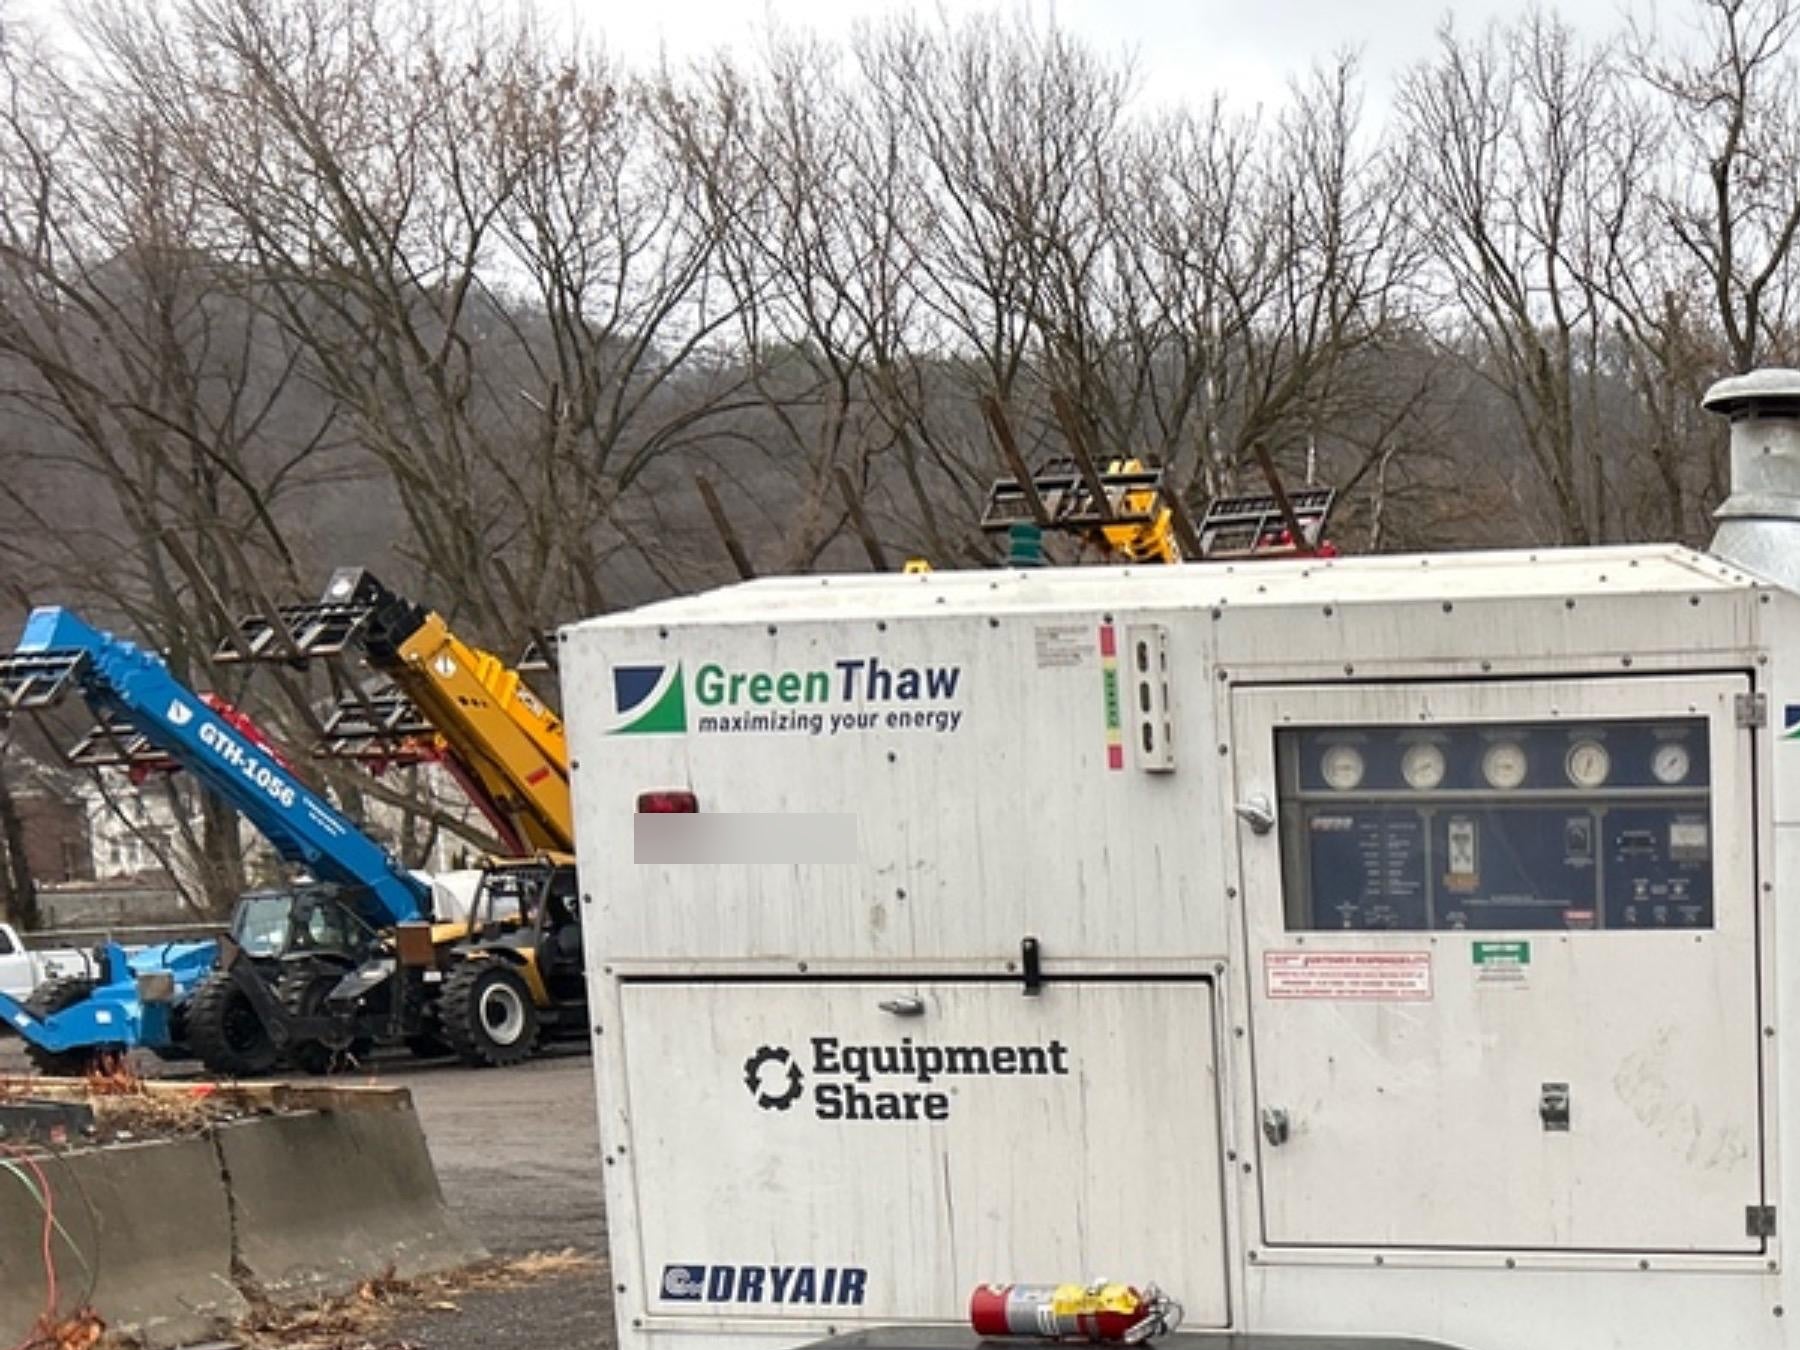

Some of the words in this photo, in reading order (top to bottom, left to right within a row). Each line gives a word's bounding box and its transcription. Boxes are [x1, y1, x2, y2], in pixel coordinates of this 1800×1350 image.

[698, 709, 823, 735] maximizing
[829, 712, 880, 735] your
[885, 709, 963, 733] energy
[198, 722, 296, 808] GTH-1056
[810, 1036, 1069, 1083] Equipment
[814, 1083, 950, 1120] Share
[706, 1265, 868, 1305] DRYAIR
